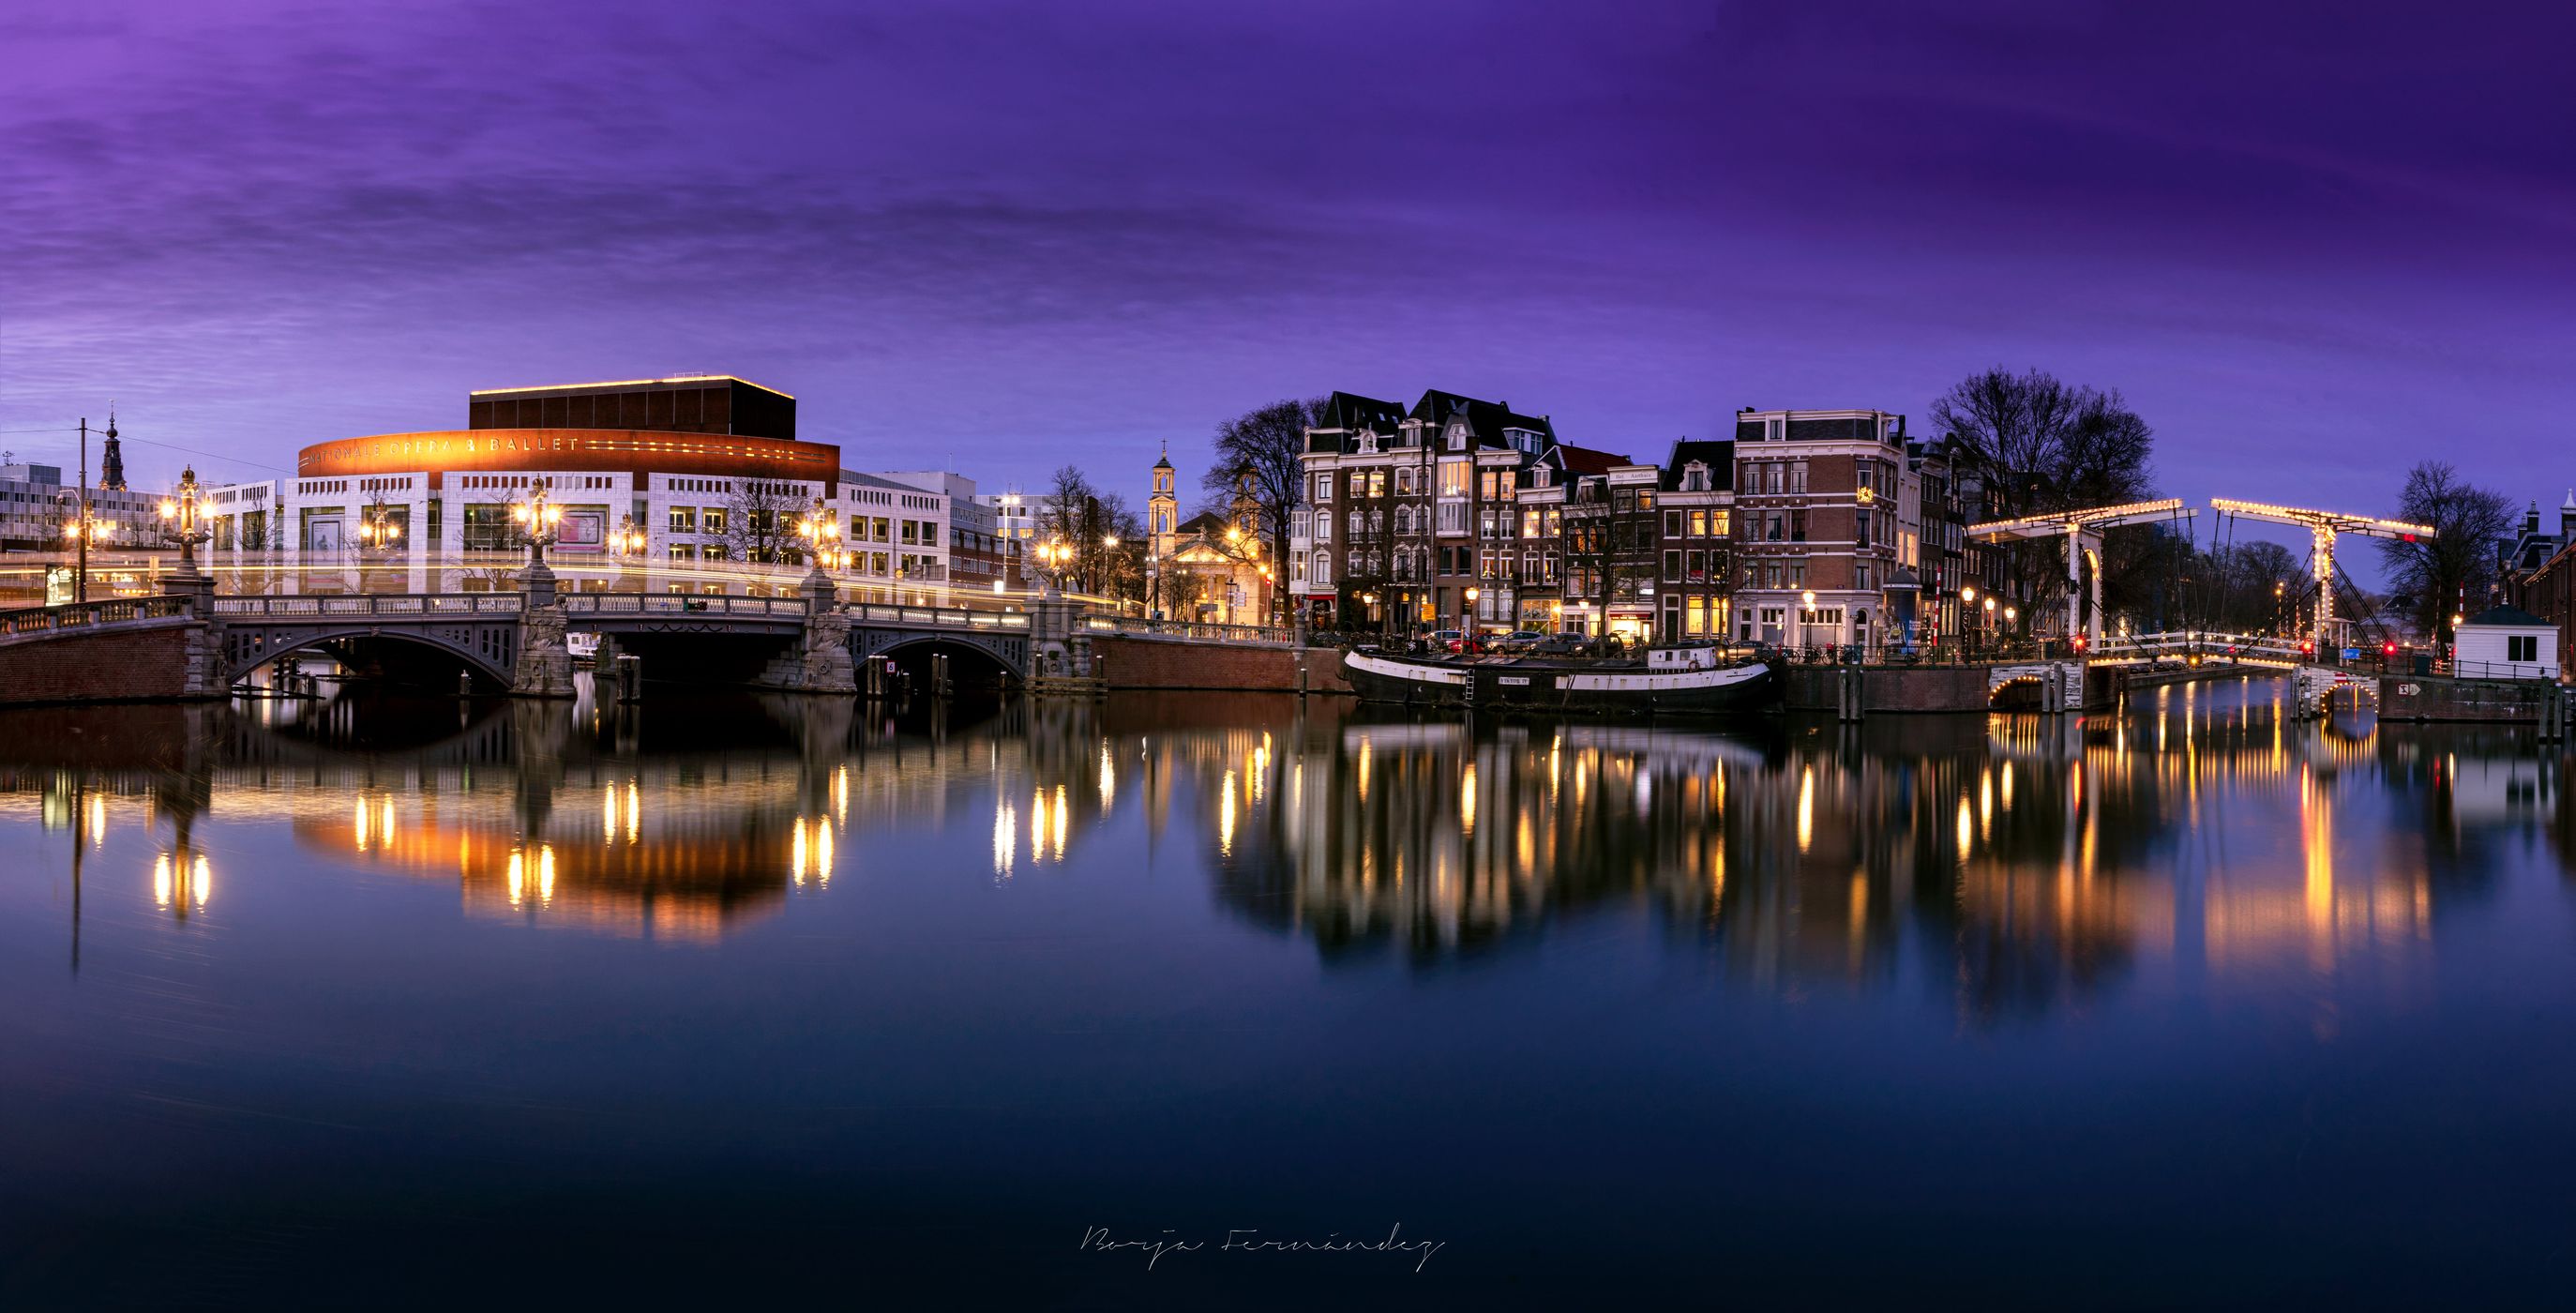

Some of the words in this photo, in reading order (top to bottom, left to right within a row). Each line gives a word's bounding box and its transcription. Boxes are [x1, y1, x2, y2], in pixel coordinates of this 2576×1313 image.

[308, 444, 380, 464] NATIONALE
[389, 441, 453, 455] OPERA
[466, 438, 475, 451] &
[490, 438, 578, 451] BALLET
